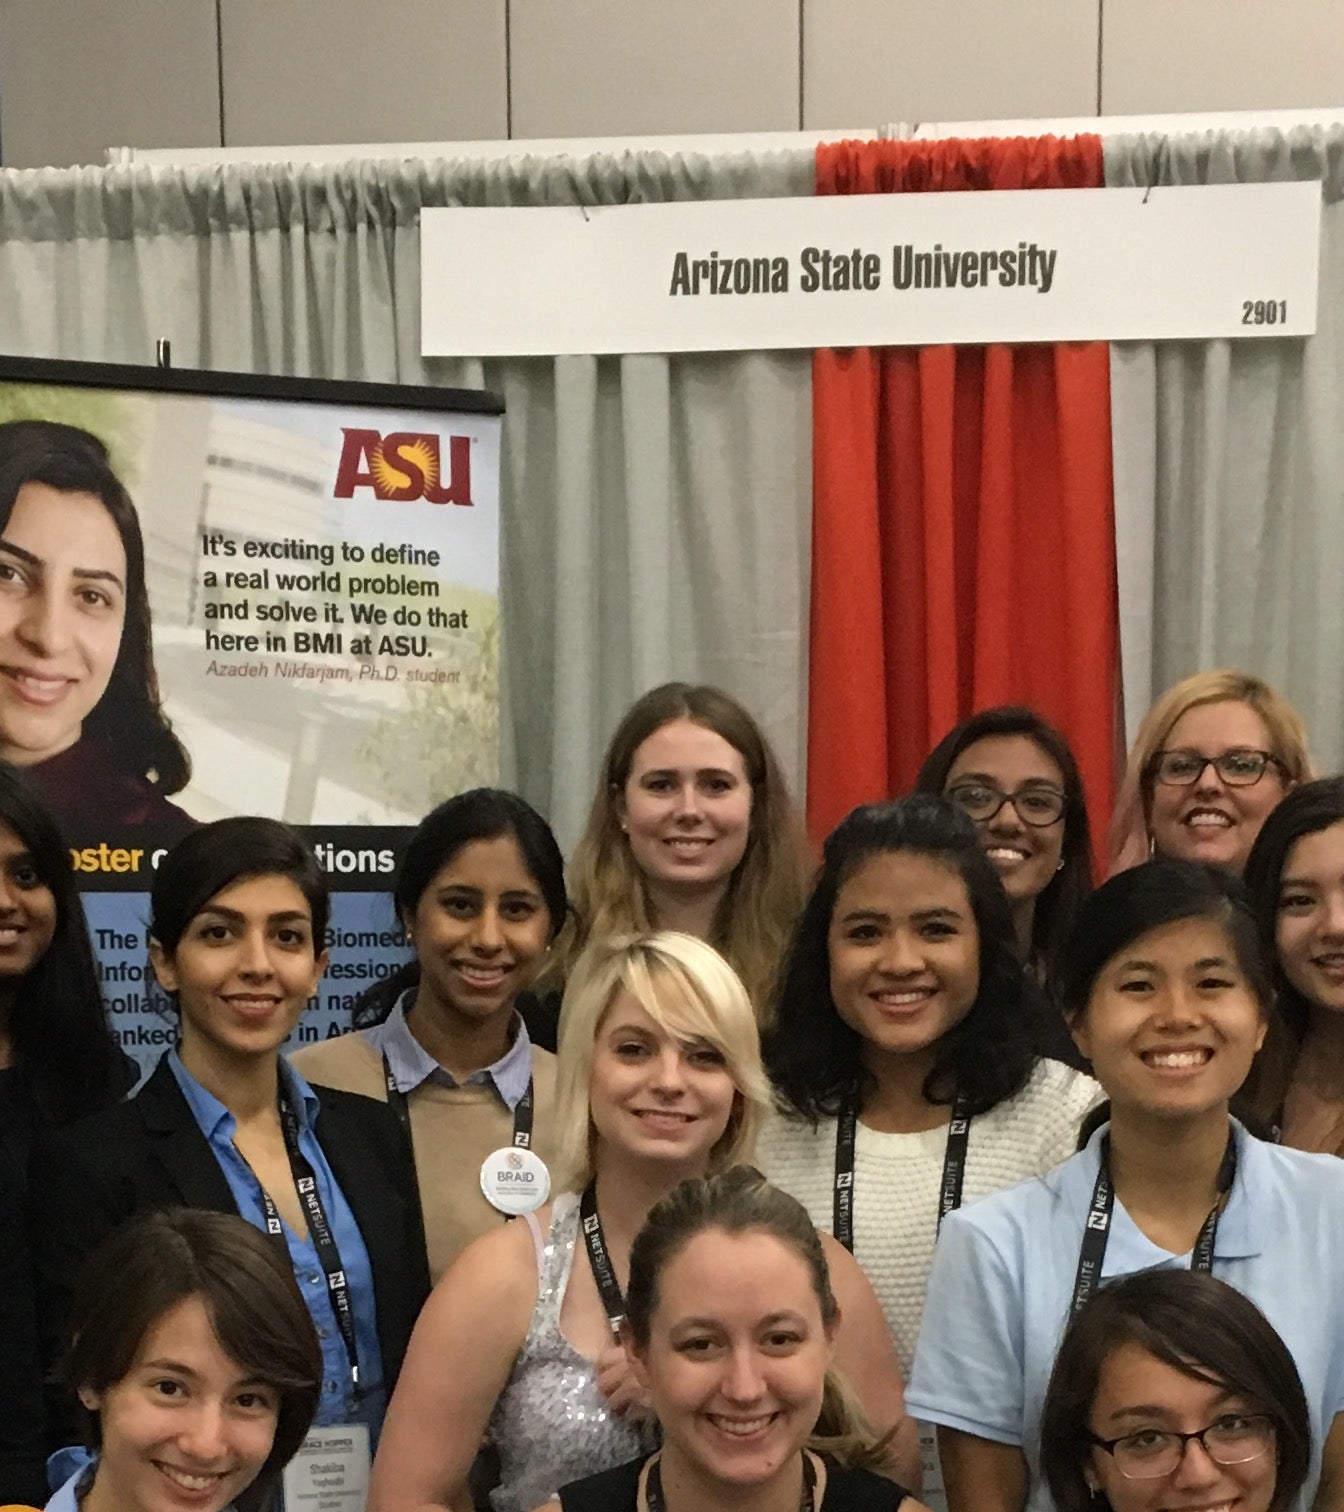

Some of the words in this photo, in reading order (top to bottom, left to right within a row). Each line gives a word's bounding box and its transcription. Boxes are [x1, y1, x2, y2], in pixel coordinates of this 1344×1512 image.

[669, 249, 789, 296] Arizona
[800, 246, 881, 294] State
[893, 242, 1057, 294] University
[1242, 300, 1287, 325] 2901
[333, 427, 474, 507] ASU
[202, 535, 237, 559] It's
[243, 537, 335, 565] exciting
[341, 542, 365, 564] to
[369, 543, 440, 568] define
[203, 572, 218, 589] a
[224, 567, 270, 592] real
[275, 568, 342, 594] world
[348, 571, 440, 602] problem
[204, 598, 249, 622] and
[256, 600, 317, 624] solve
[323, 601, 345, 626] it.
[350, 602, 387, 626] We
[393, 604, 422, 628] do
[427, 606, 469, 629] that
[205, 628, 259, 654] here
[266, 630, 287, 654] in
[294, 631, 343, 656] BMI
[349, 633, 372, 657] at
[377, 633, 433, 658] ASU.
[206, 660, 269, 679] Azadeh
[274, 661, 353, 683] Nikfarjam,
[359, 664, 402, 683] Ph.D.
[406, 667, 461, 685] student
[95, 929, 138, 950] The
[299, 1023, 318, 1041] in
[497, 1171, 534, 1182] BRAID
